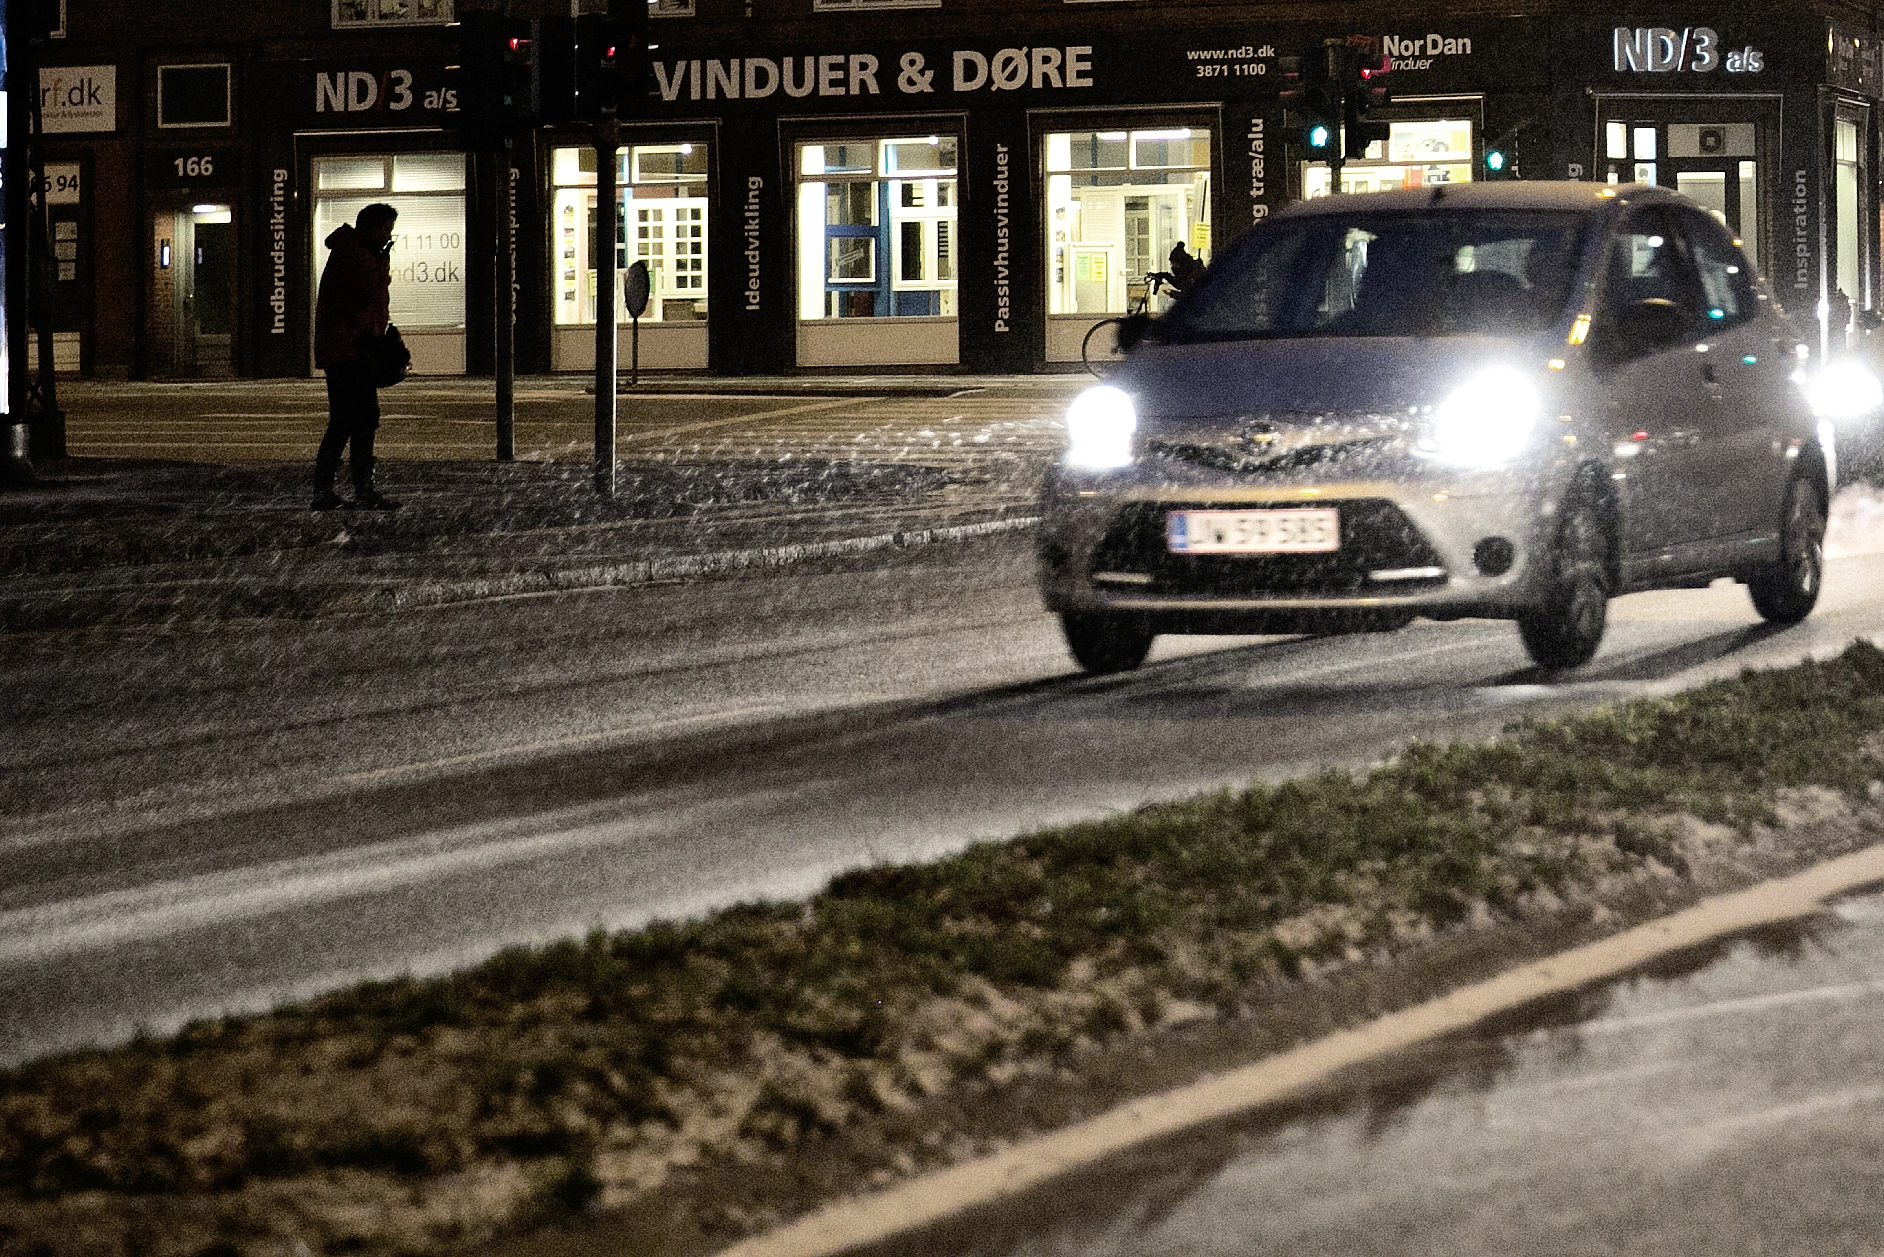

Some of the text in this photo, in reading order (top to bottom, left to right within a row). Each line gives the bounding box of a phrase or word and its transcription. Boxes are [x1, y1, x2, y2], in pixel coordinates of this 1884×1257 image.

[1187, 45, 1275, 62] www.nd3.dk
[1196, 63, 1267, 78] 3871 1100
[1391, 56, 1433, 71] induer
[652, 45, 1095, 101] VINDUER & DØRE
[174, 157, 213, 177] 166
[1248, 118, 1265, 197] træ/alu
[56, 174, 79, 192] 94
[440, 232, 460, 249] 00
[745, 176, 763, 311] Ideudvikling
[994, 144, 1010, 333] Passivhusvinduer
[1793, 169, 1808, 289] Inspiration
[271, 168, 288, 334] Indbrudssikring
